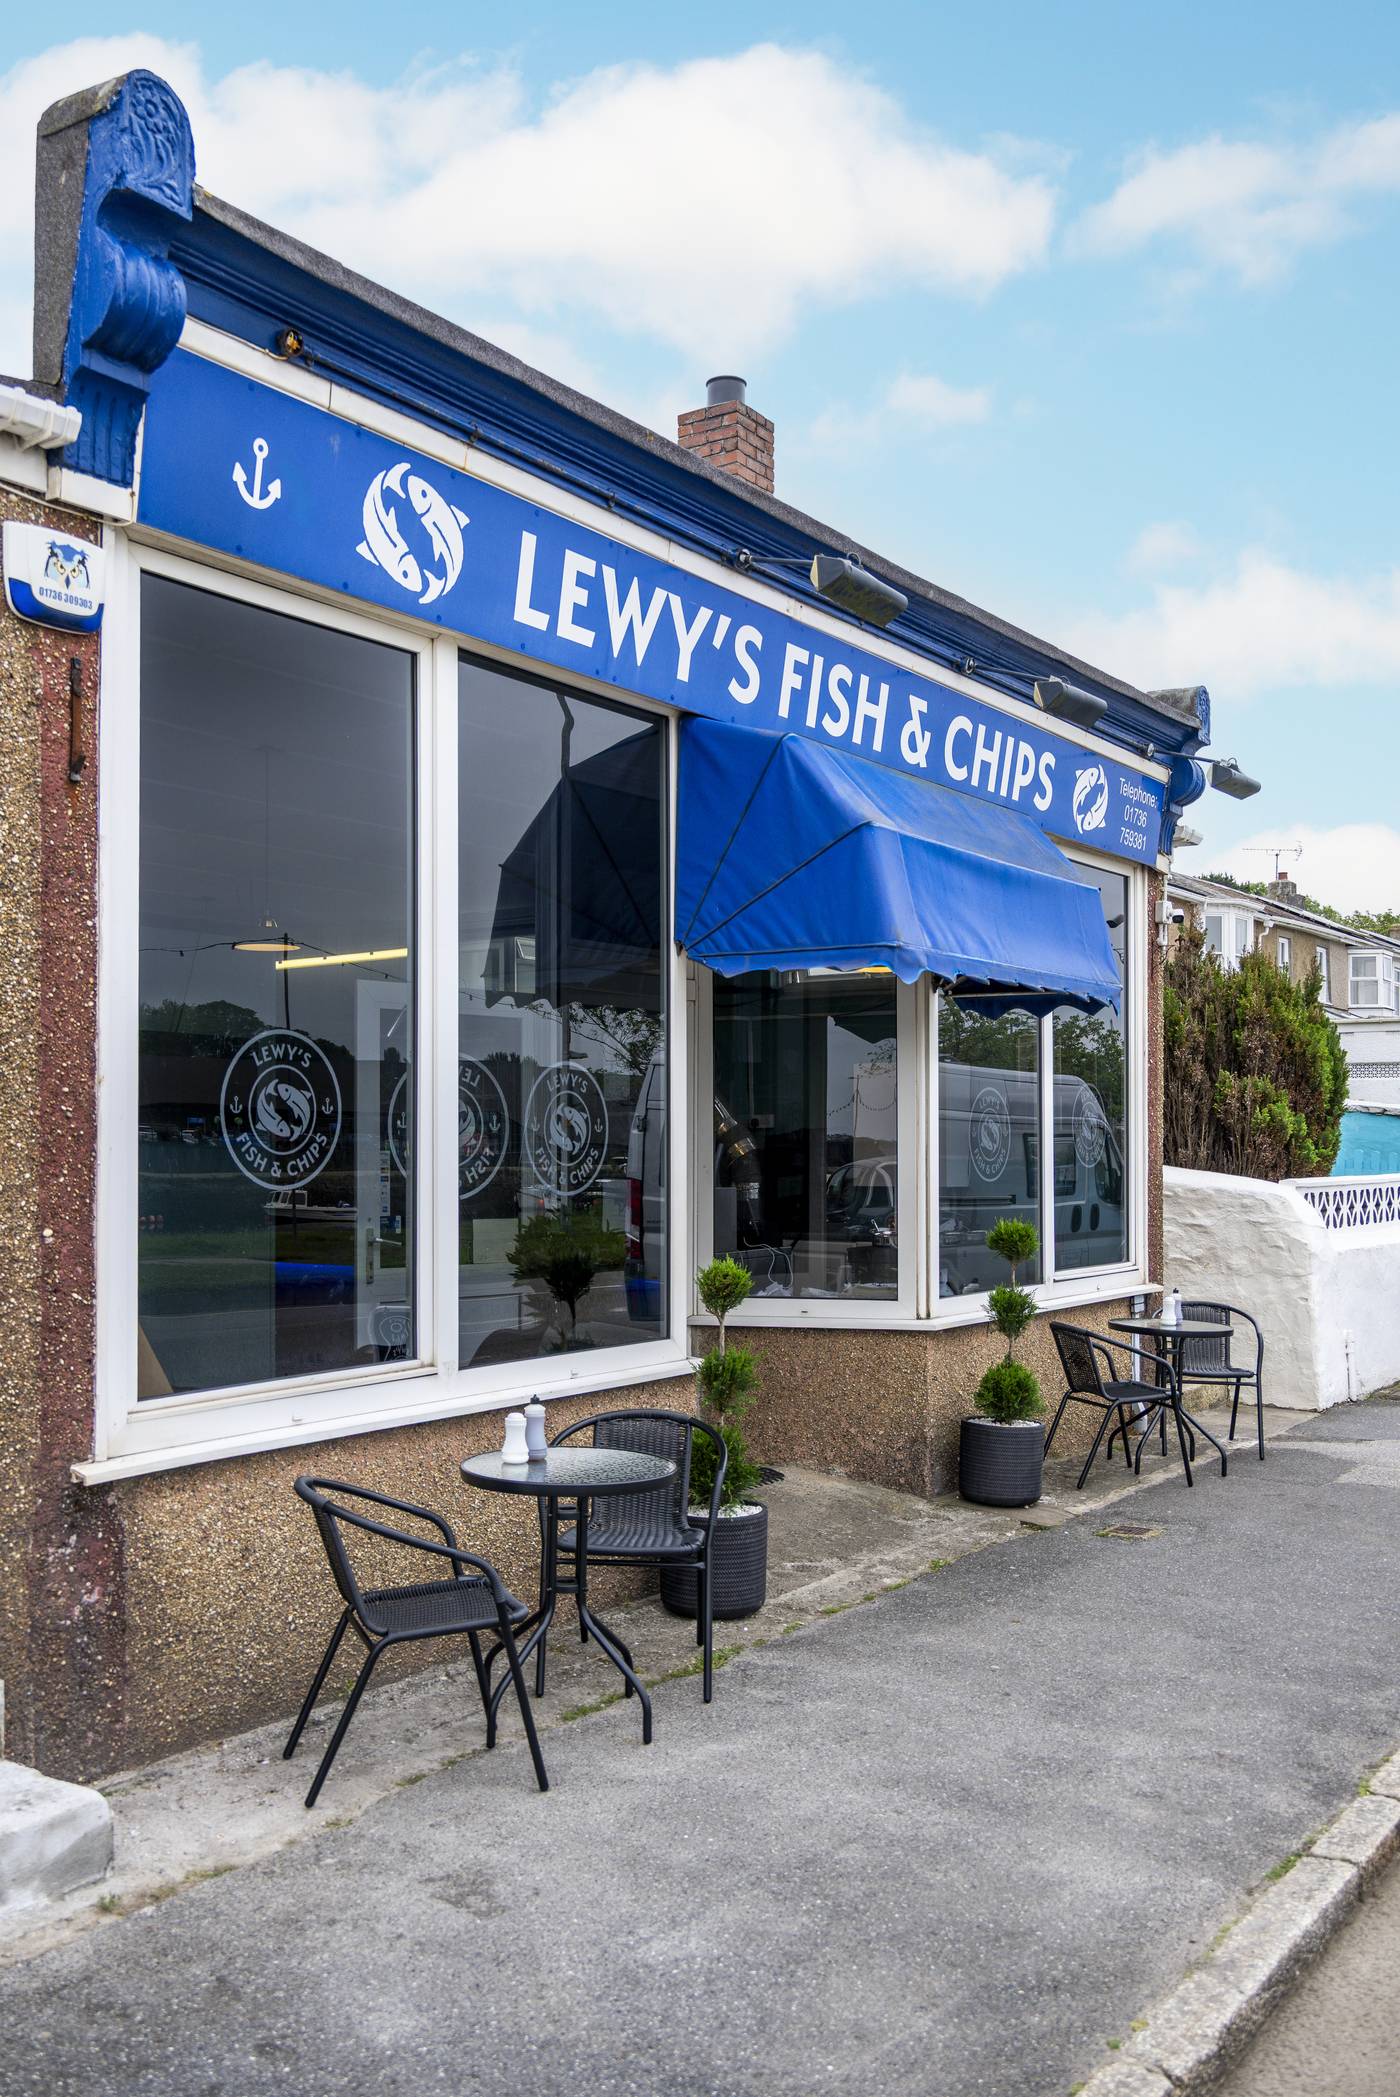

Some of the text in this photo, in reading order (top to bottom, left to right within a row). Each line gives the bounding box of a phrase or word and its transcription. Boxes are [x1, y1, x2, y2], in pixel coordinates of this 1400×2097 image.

[39, 586, 93, 610] 01736 309303
[513, 530, 1057, 812] LEWY'S FISH & CHIPS
[1119, 777, 1159, 809] Telephone:
[1124, 804, 1148, 828] 01736
[1119, 827, 1147, 851] 759381
[251, 1043, 312, 1068] LEWY'S
[546, 1073, 589, 1093] LEWY'S
[236, 1132, 328, 1178] FISH & CHIPS
[535, 1146, 557, 1177] FISH
[569, 1147, 599, 1185] CHIPS
